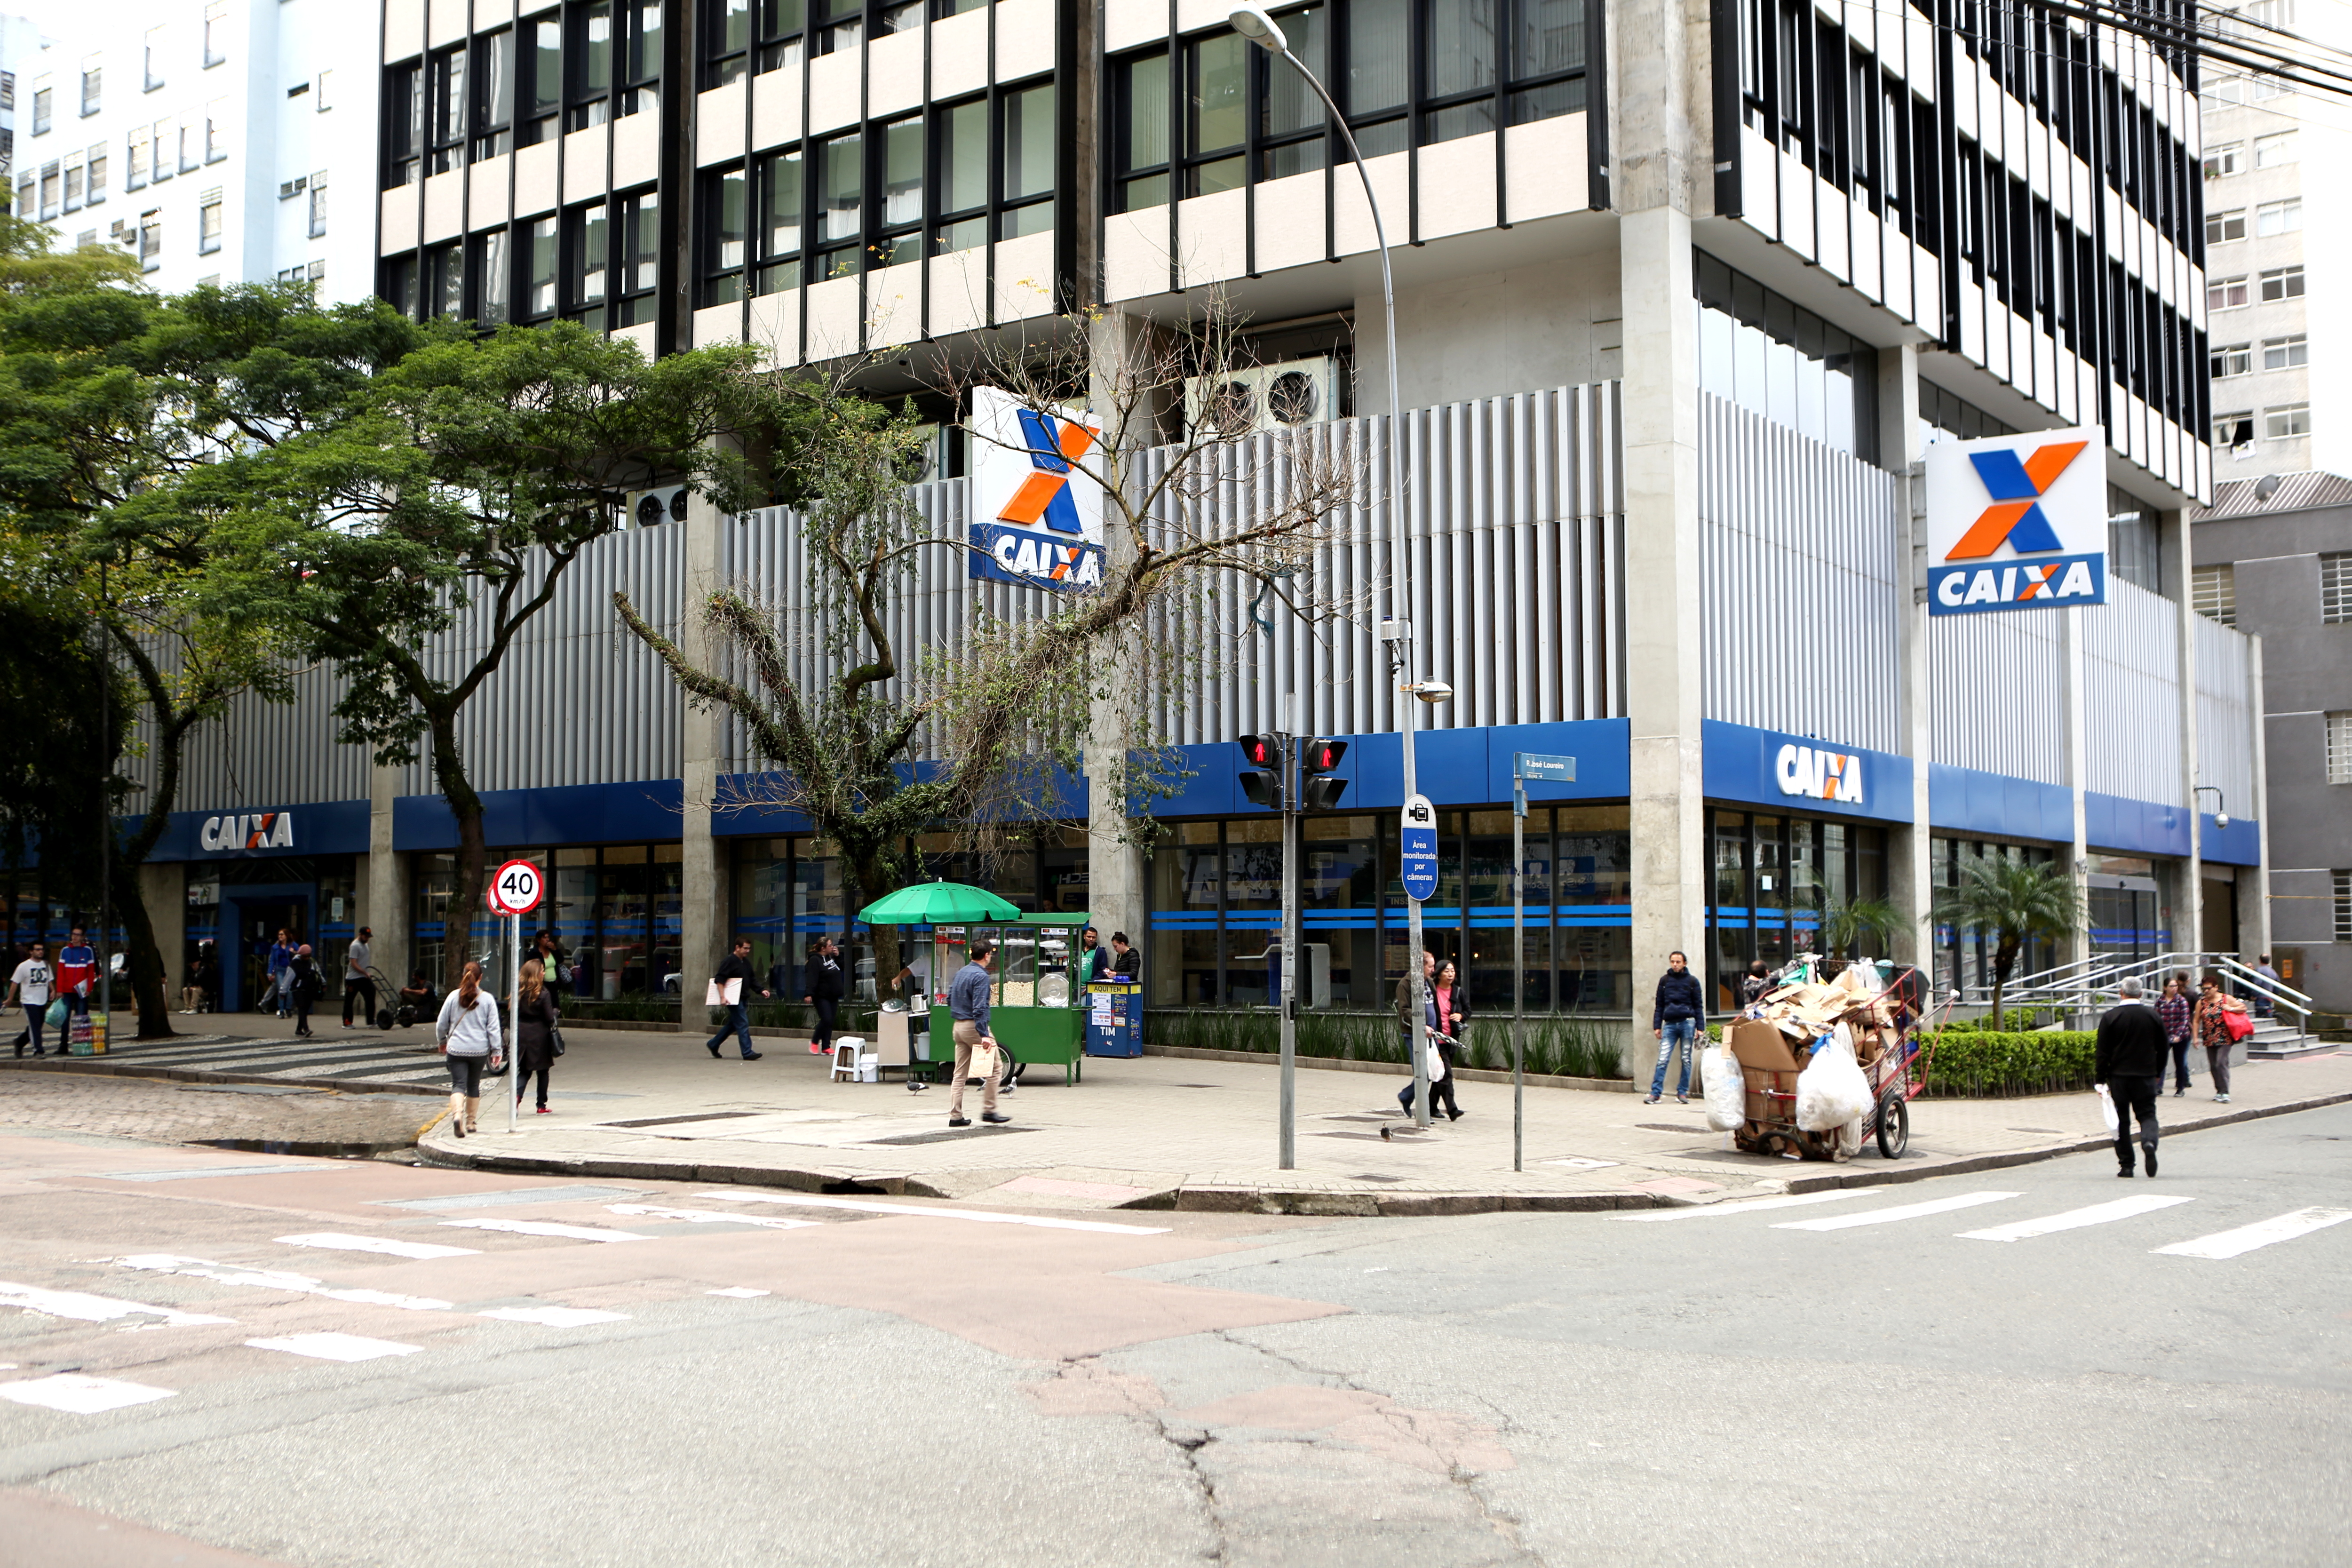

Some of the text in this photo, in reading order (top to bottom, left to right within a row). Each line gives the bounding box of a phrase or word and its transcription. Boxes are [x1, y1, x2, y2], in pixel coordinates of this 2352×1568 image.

[994, 533, 1102, 588] CAIXA
[1937, 560, 2094, 607] CAIXA
[1776, 743, 1863, 804] CAIXA
[201, 812, 294, 852] CAIXA
[1413, 839, 1427, 849] Área
[501, 873, 533, 895] 40
[30, 967, 47, 984] DC
[1100, 1027, 1115, 1036] TIM
